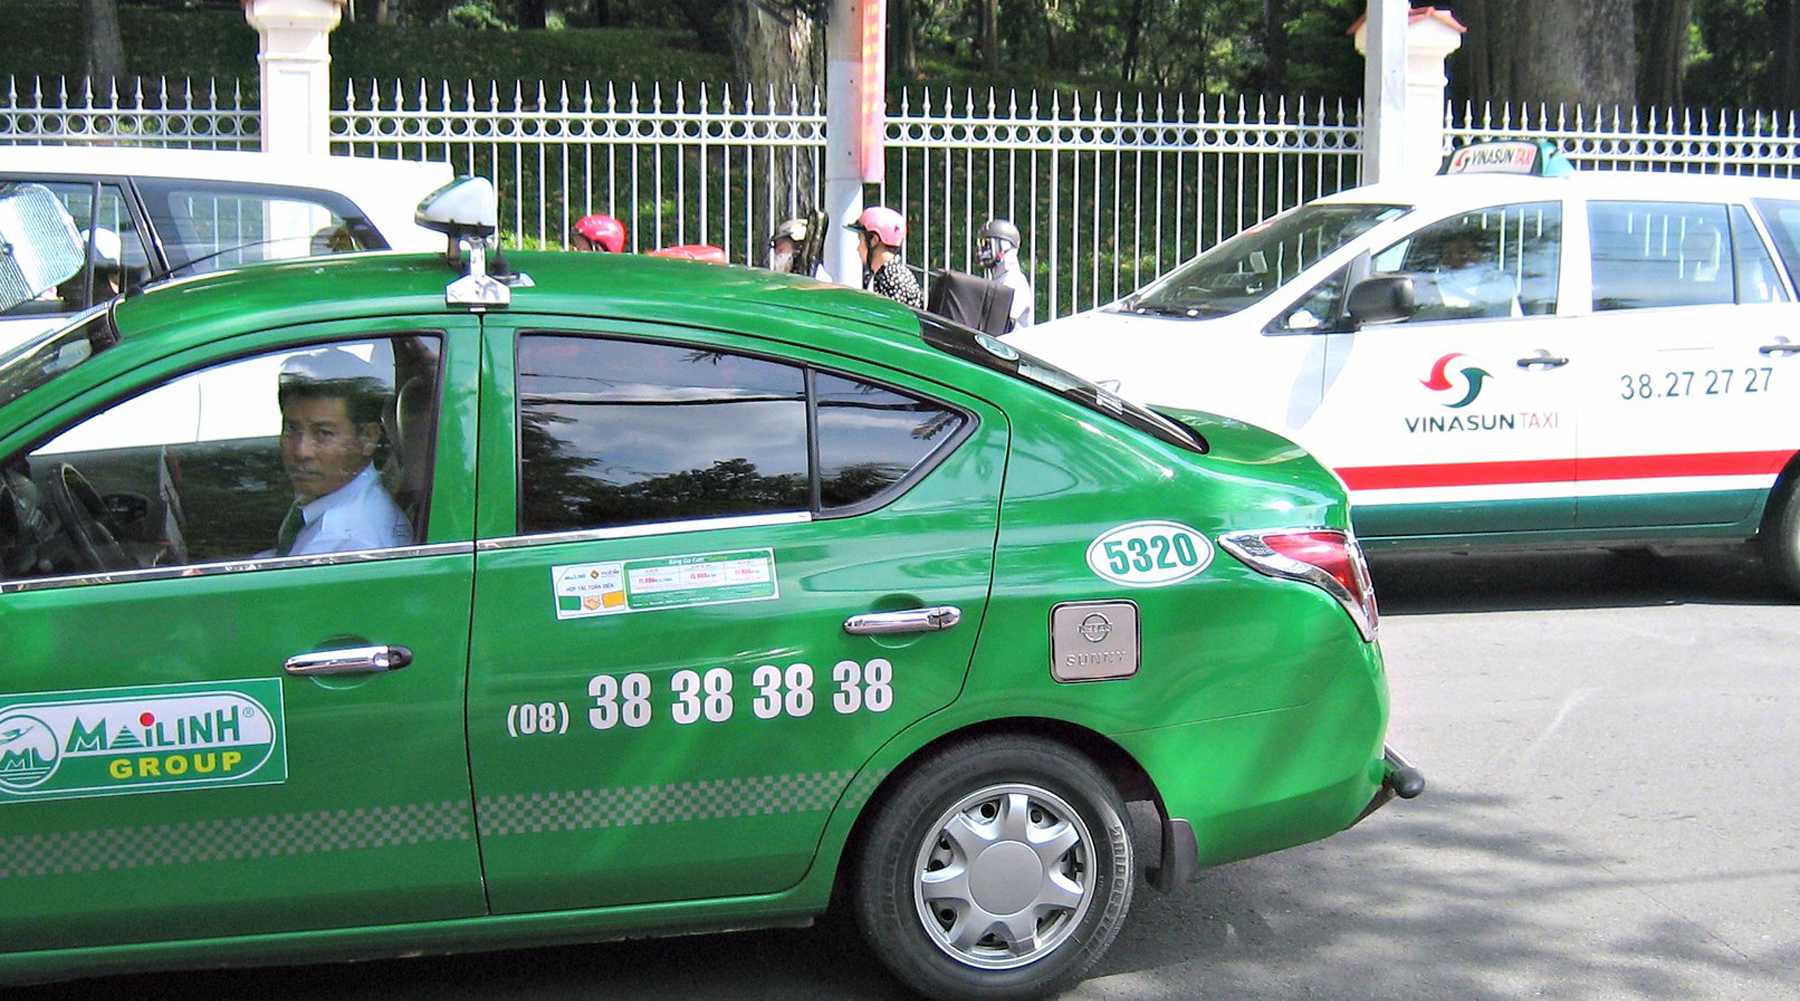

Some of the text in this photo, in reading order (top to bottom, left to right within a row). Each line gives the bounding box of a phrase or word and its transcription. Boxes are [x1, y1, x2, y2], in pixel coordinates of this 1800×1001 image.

[1472, 149, 1514, 165] VINASUN
[1704, 369, 1734, 395] 27
[1744, 367, 1773, 393] 27
[1405, 411, 1559, 433] VINASUN TAXI
[1103, 532, 1199, 575] 5320
[506, 658, 894, 738] (08) 38 38 38 38
[109, 751, 242, 779] GROUP
